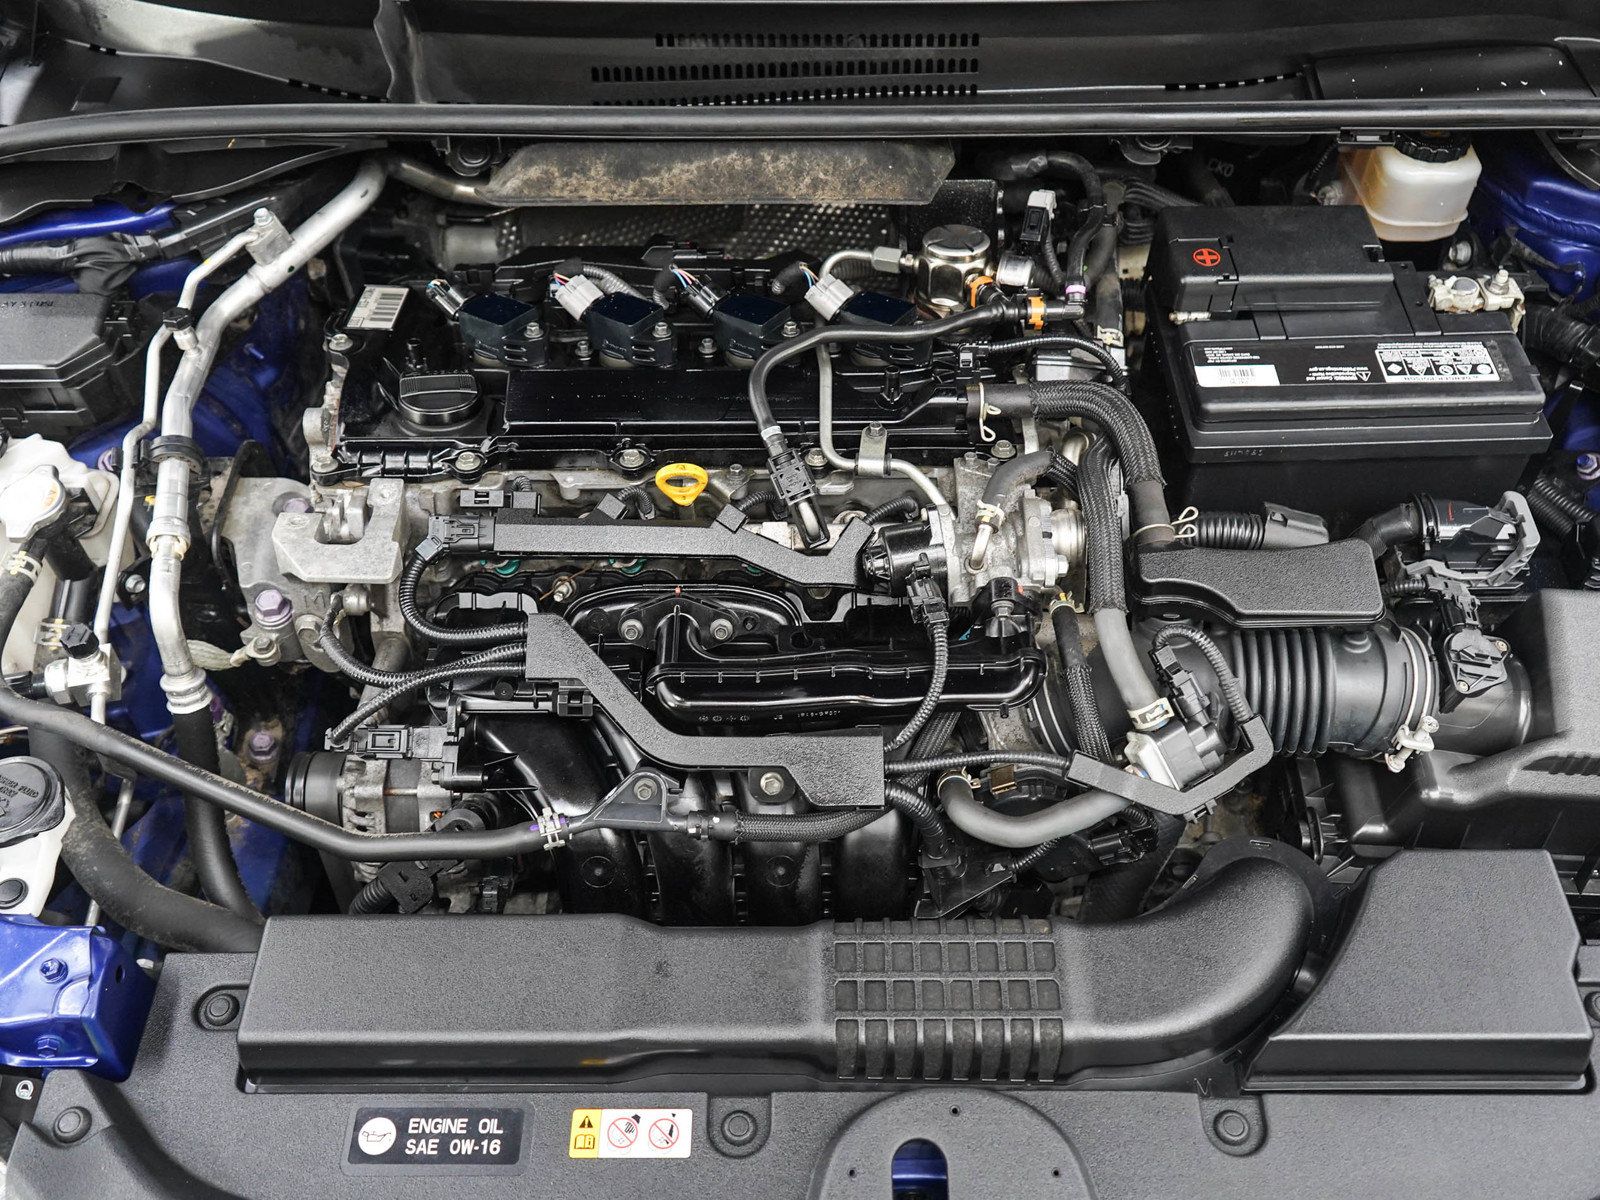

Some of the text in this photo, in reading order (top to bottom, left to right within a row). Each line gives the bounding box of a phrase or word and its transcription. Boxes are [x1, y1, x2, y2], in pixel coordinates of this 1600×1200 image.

[408, 1118, 504, 1134] ENGINE OIL
[404, 1138, 440, 1155] SAE
